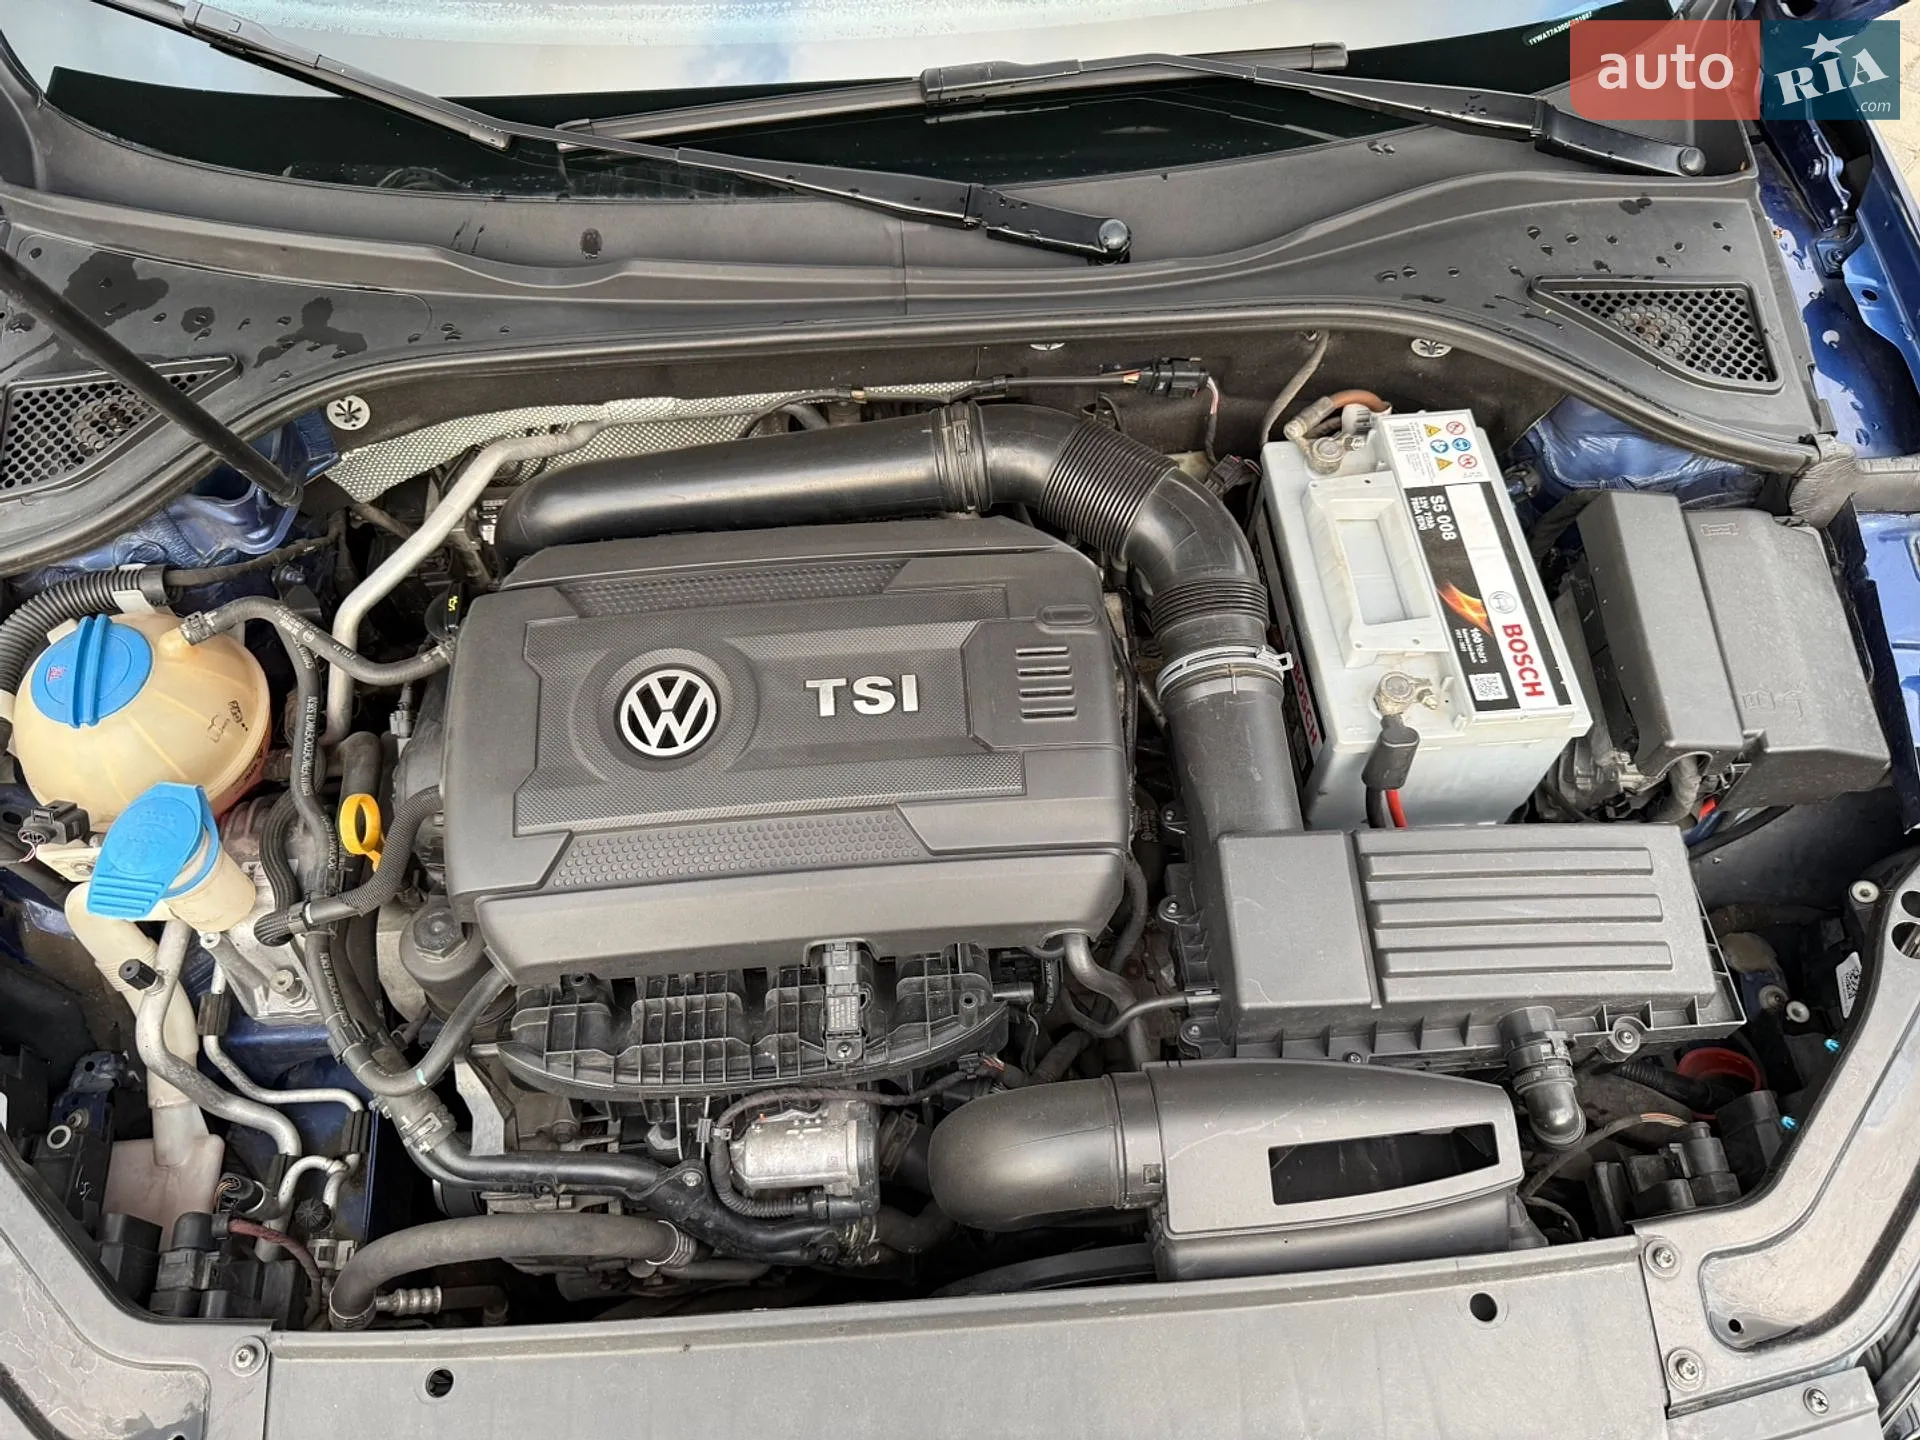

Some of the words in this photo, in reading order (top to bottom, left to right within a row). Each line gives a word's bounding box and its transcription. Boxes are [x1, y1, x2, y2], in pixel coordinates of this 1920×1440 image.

[1430, 495, 1448, 513] S5
[1436, 515, 1457, 541] 008
[1502, 623, 1545, 698] BOSCH
[805, 674, 919, 717] TSI
[1293, 661, 1318, 746] BOSCH
